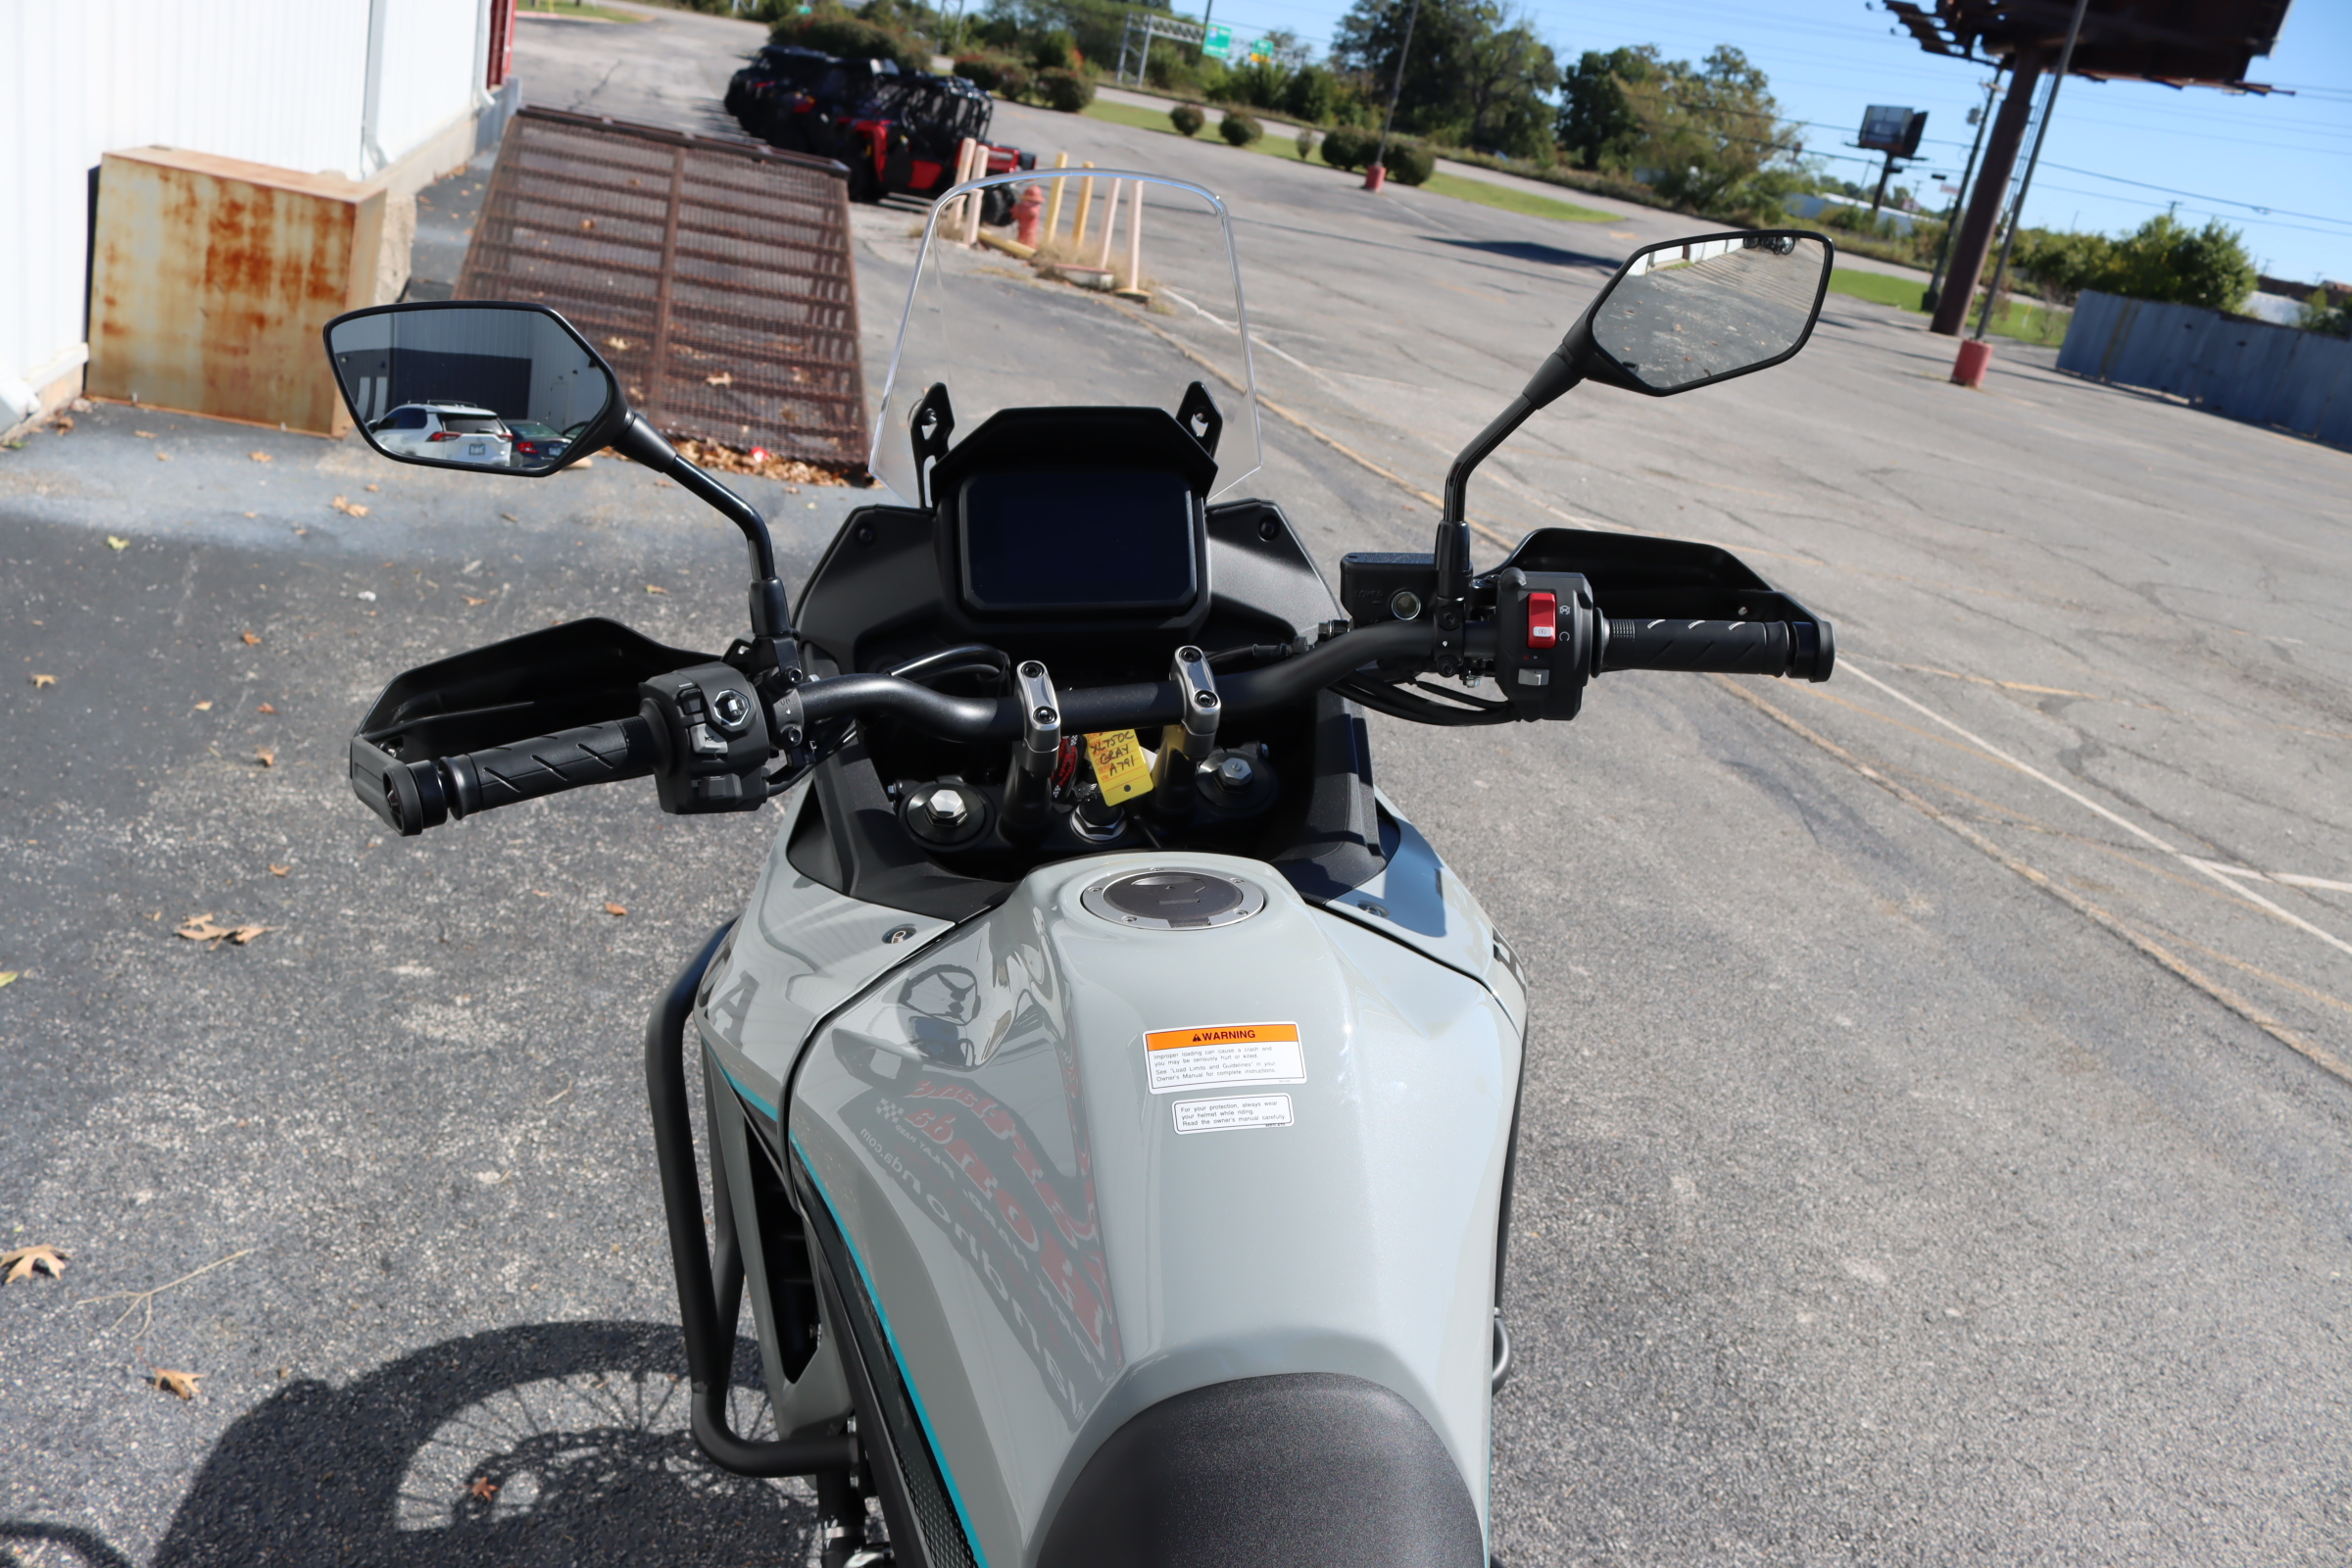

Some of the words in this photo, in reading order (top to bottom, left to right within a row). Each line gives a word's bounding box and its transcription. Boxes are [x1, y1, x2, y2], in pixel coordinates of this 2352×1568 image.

[1100, 744, 1129, 764] GRAY
[1109, 755, 1135, 776] A791
[1202, 1030, 1255, 1041] WARNING
[1153, 1052, 1179, 1060] Improper
[1209, 1102, 1240, 1111] protection,
